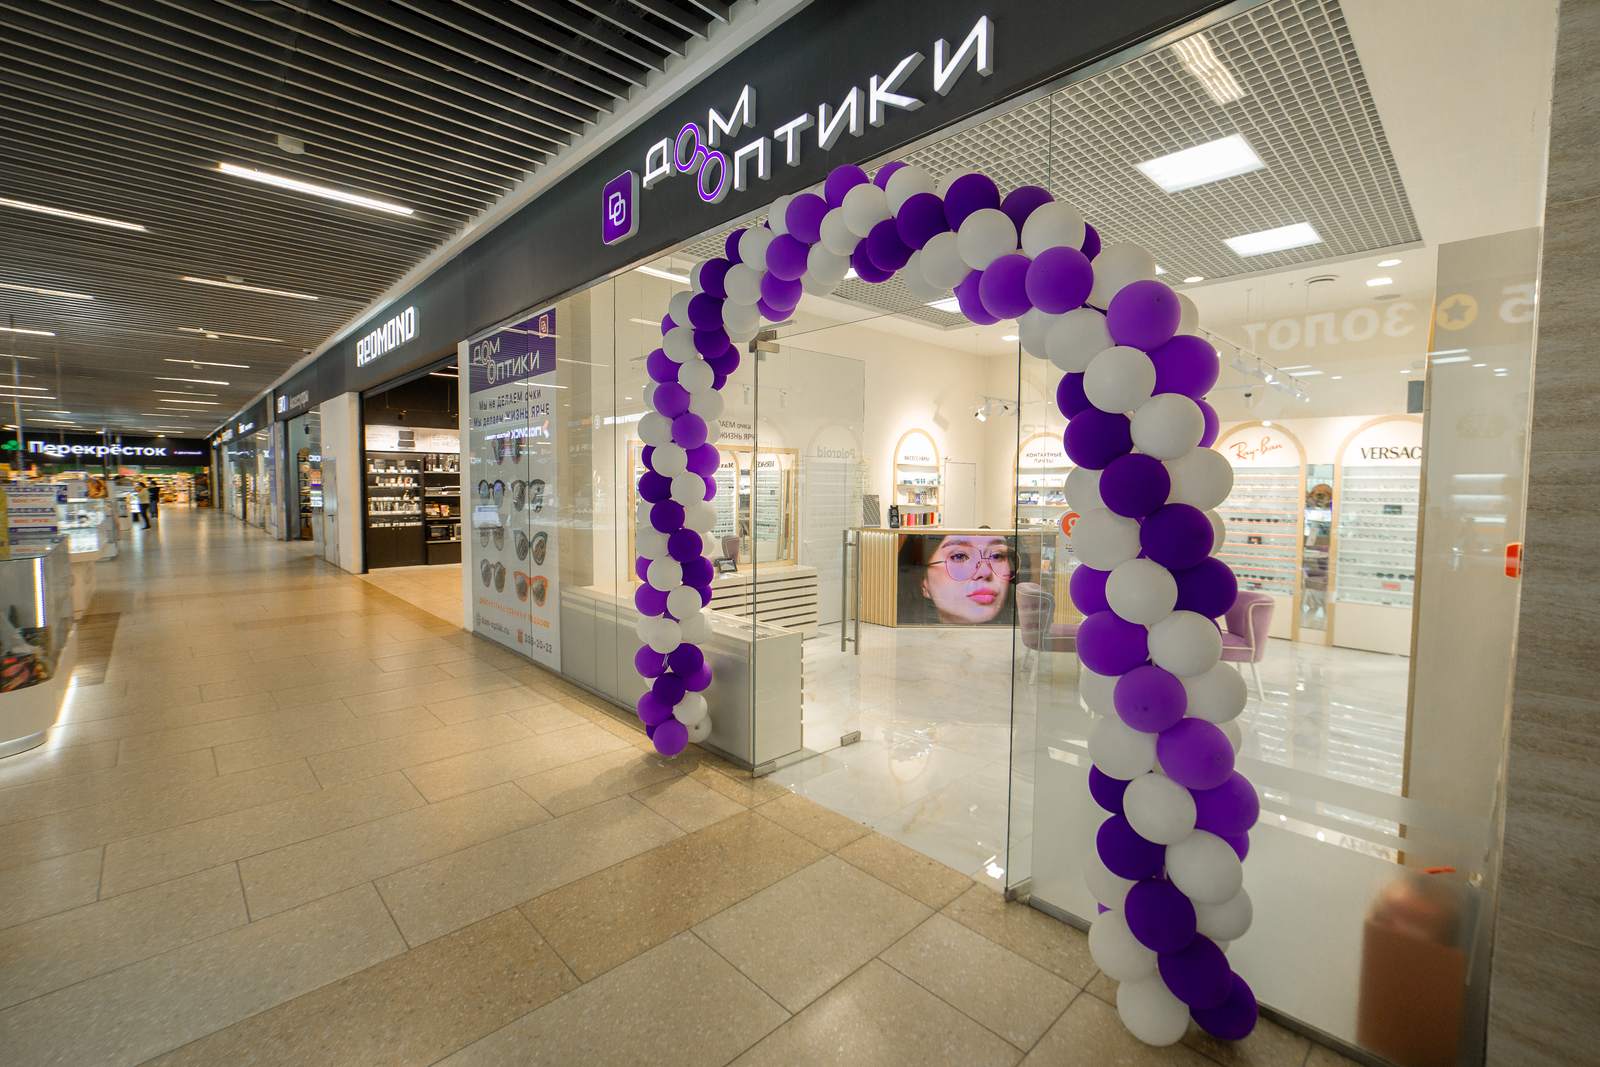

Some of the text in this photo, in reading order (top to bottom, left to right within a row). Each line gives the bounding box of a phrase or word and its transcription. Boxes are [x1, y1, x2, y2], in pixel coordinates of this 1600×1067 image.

[698, 15, 994, 204] ОПТИКИ
[643, 84, 757, 190] ДОМ
[473, 337, 501, 366] ДОМ
[487, 350, 540, 385] ОПТИКИ
[531, 402, 550, 418] ЯРЧЕ
[28, 440, 168, 458] Перекрёсток
[1360, 446, 1422, 460] VERSAC
